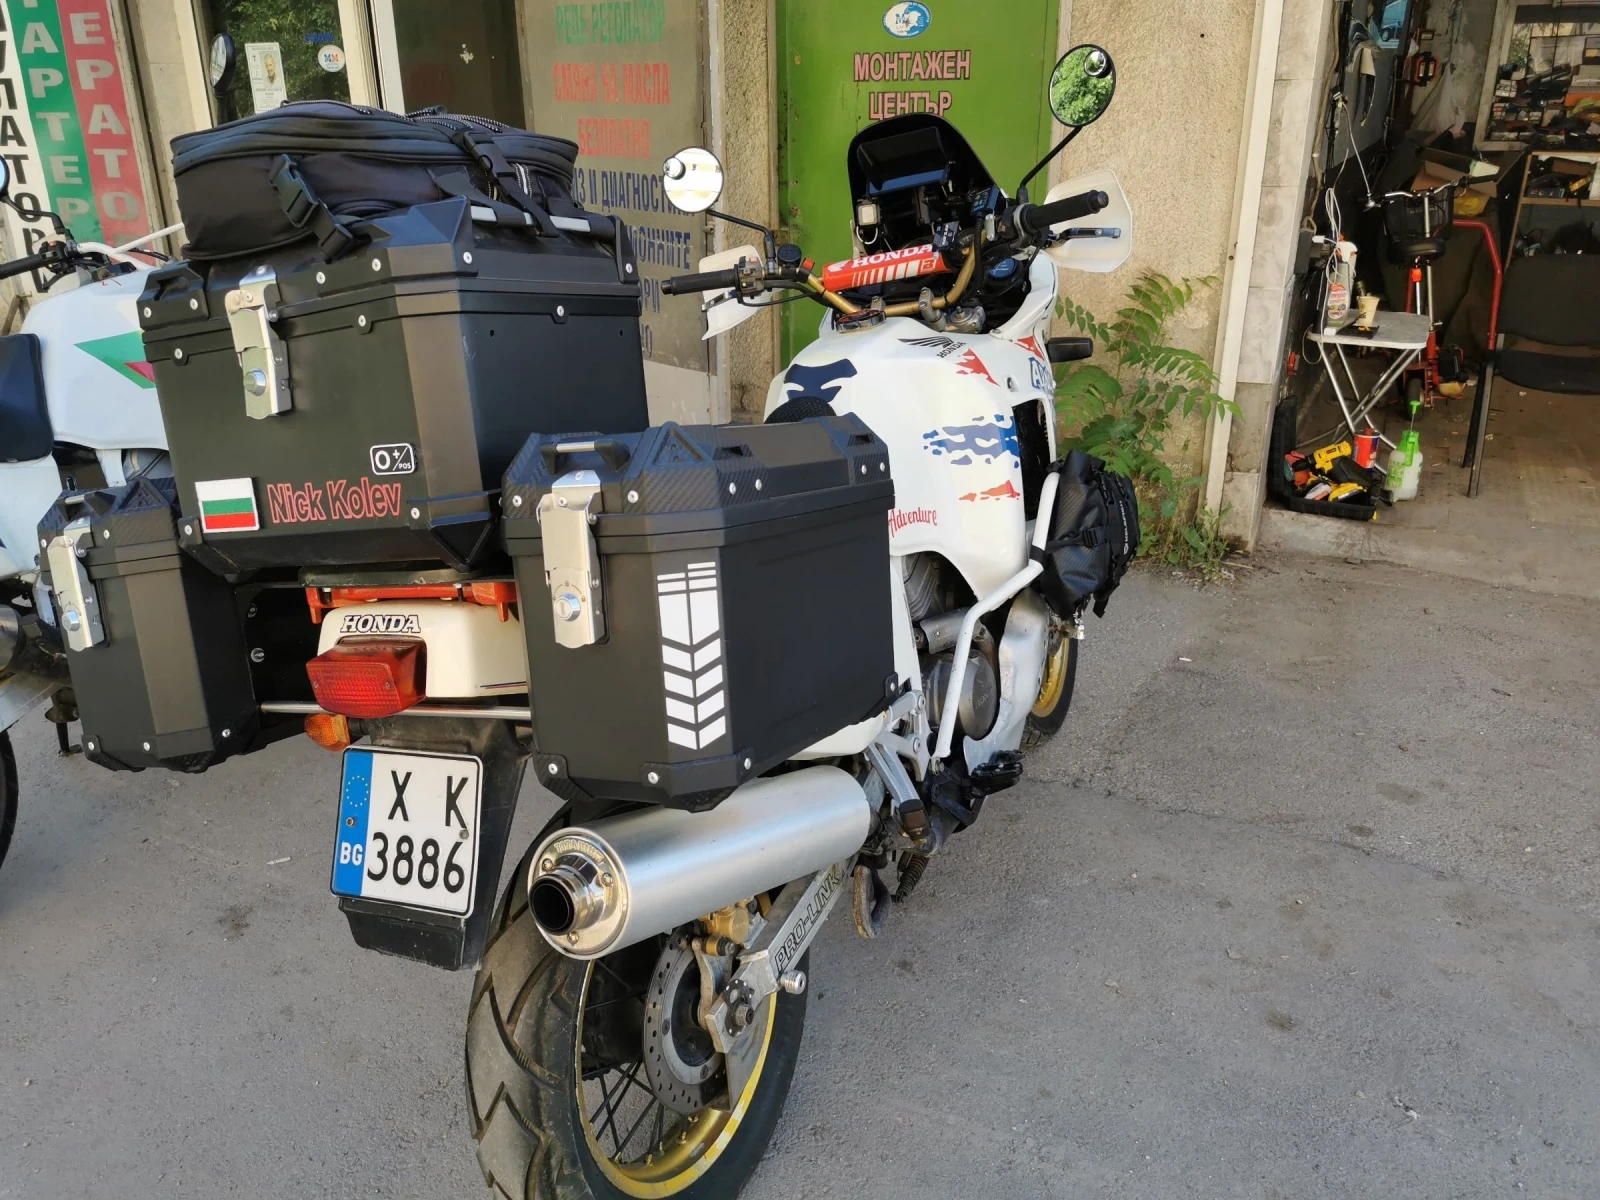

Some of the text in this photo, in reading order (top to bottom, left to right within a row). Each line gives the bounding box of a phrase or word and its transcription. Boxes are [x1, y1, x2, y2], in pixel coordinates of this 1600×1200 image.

[853, 50, 971, 82] МОНТАЖЕН
[22, 0, 90, 225] АРТЕР
[869, 90, 953, 121] ЦЕНТЪР
[588, 169, 598, 205] И
[852, 244, 934, 267] HONDA
[936, 341, 967, 358] HONDA
[267, 477, 401, 523] Nick Kolev
[888, 506, 938, 538] Adventure
[340, 614, 421, 634] HONDA
[340, 841, 363, 866] BG
[367, 831, 466, 893] 3886
[774, 863, 840, 971] PRO-LINK
